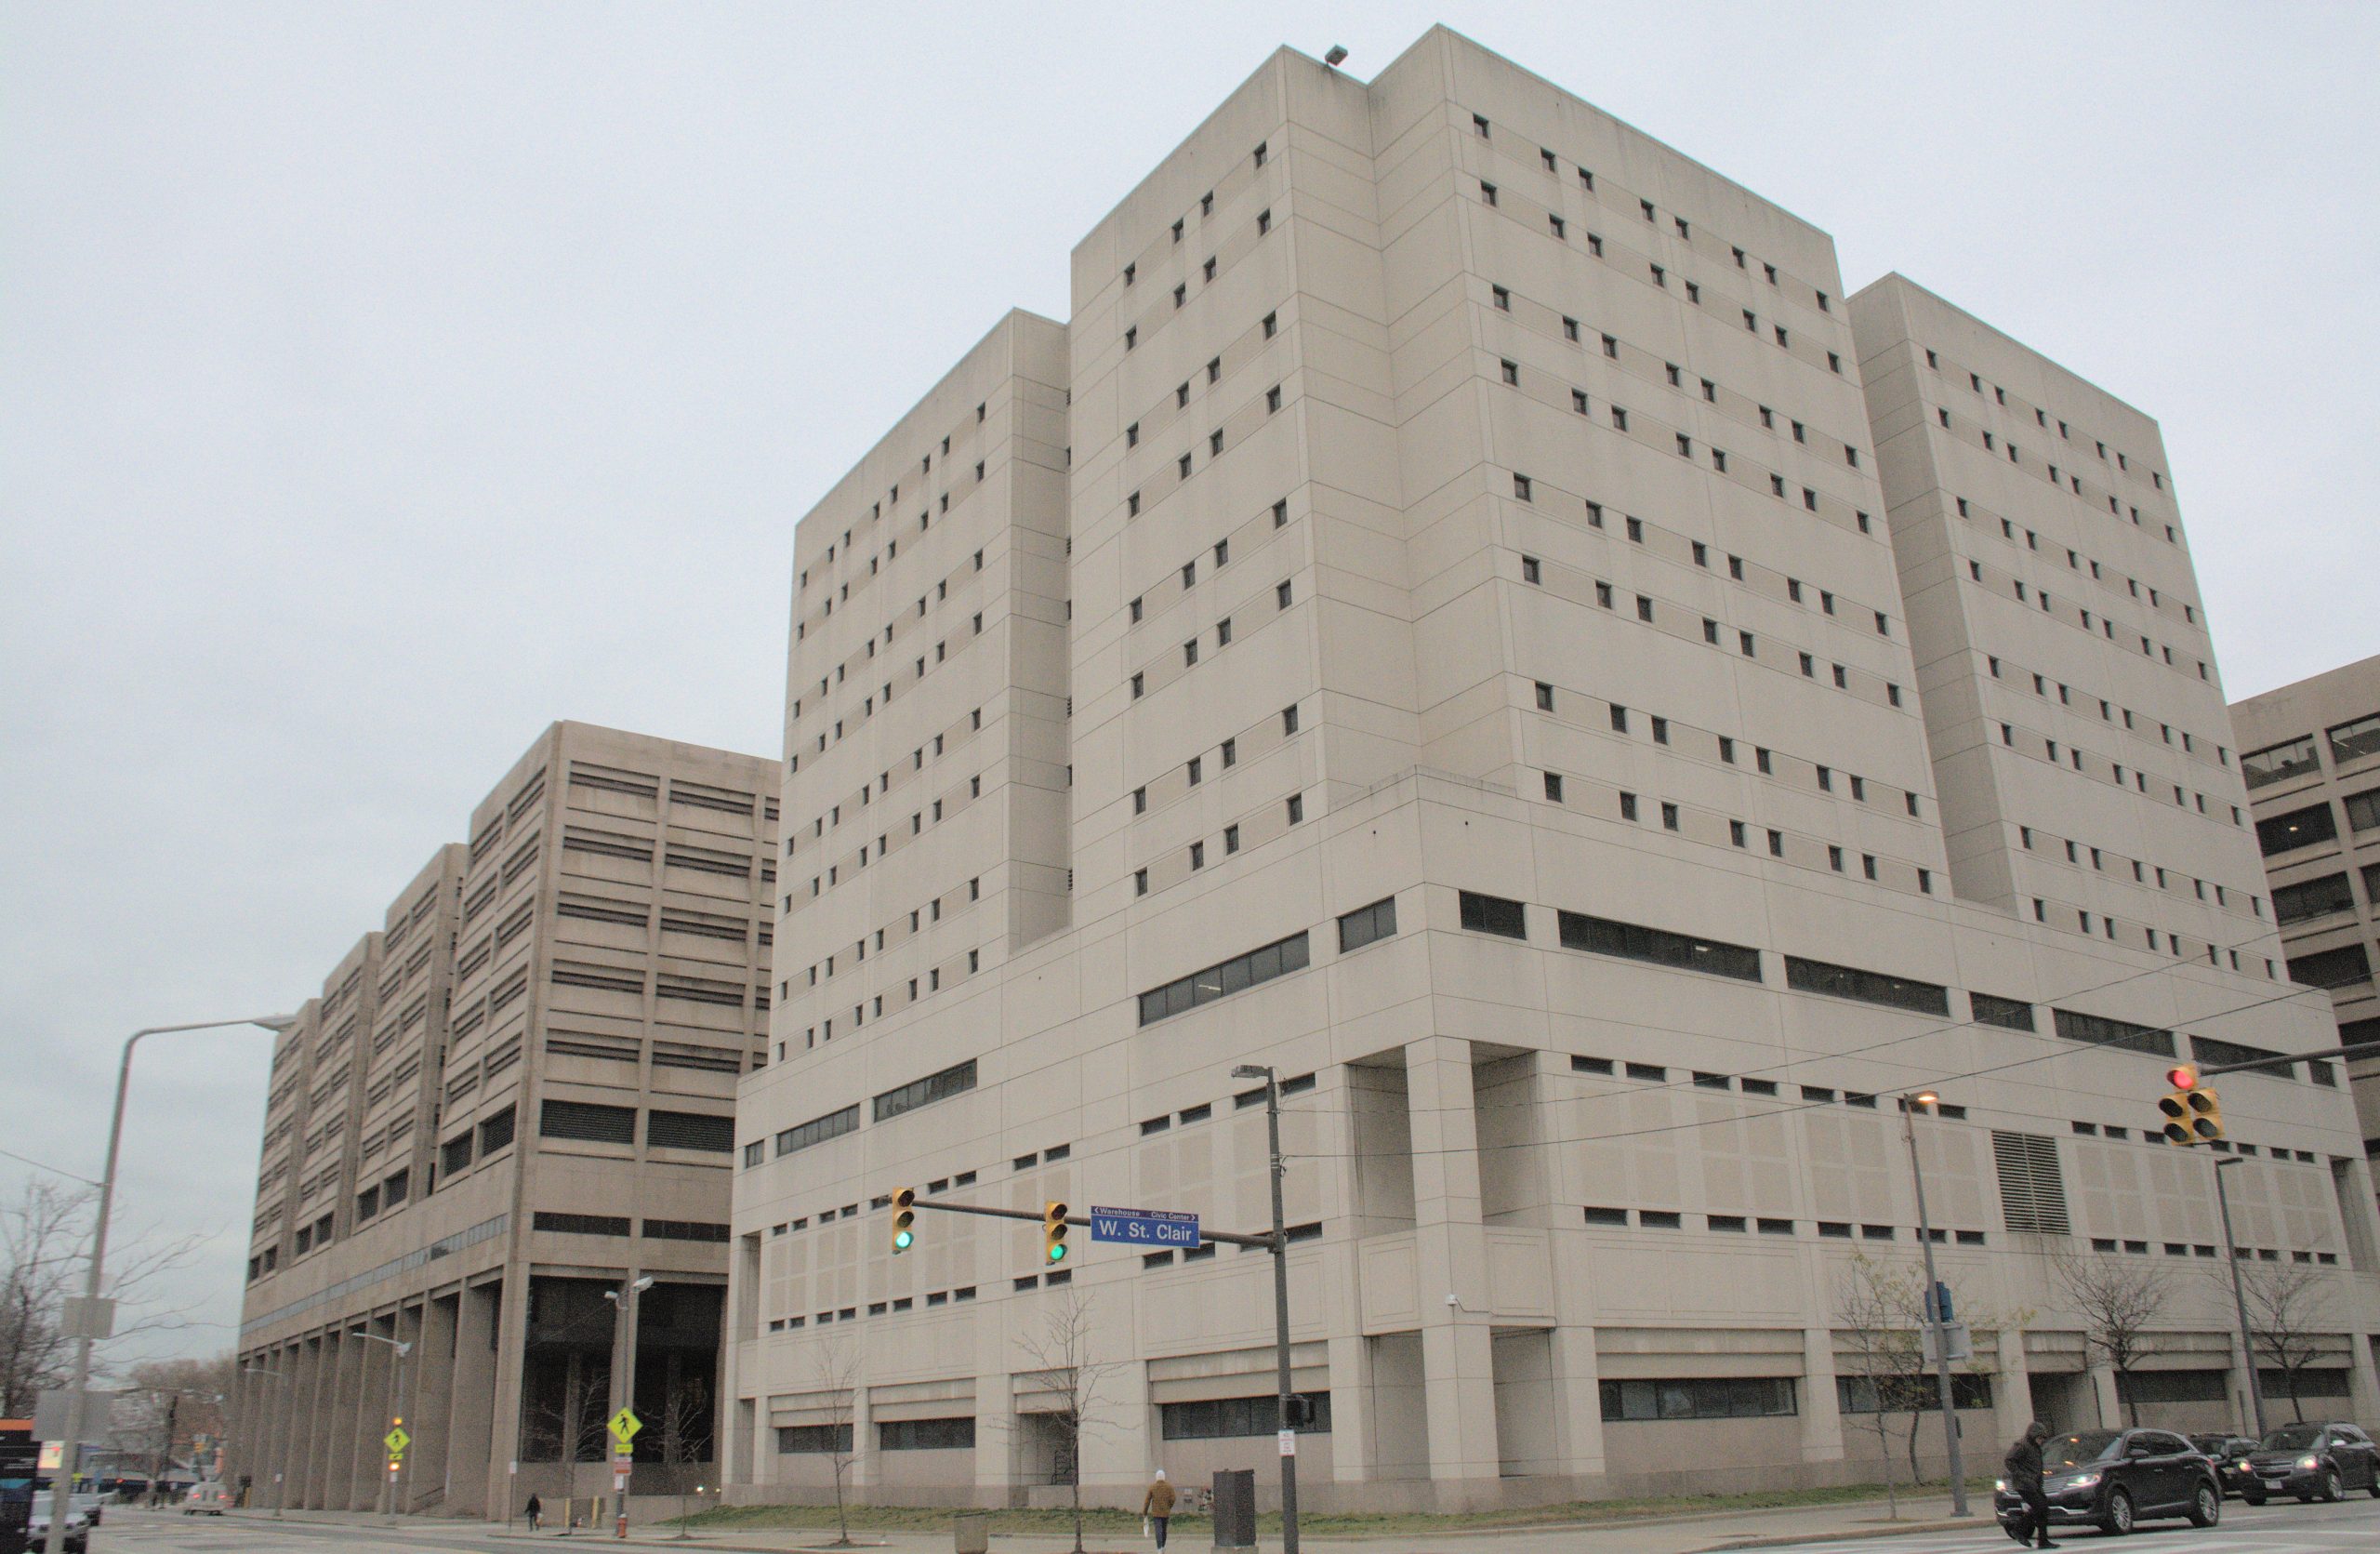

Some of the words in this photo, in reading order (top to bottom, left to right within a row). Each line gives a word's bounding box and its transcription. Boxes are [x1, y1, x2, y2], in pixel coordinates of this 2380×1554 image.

[1100, 1207, 1140, 1216] Warehouse
[1169, 1213, 1189, 1221] Center
[1099, 1219, 1121, 1237] W.
[1129, 1222, 1150, 1239] St.
[1157, 1224, 1192, 1241] Clair
